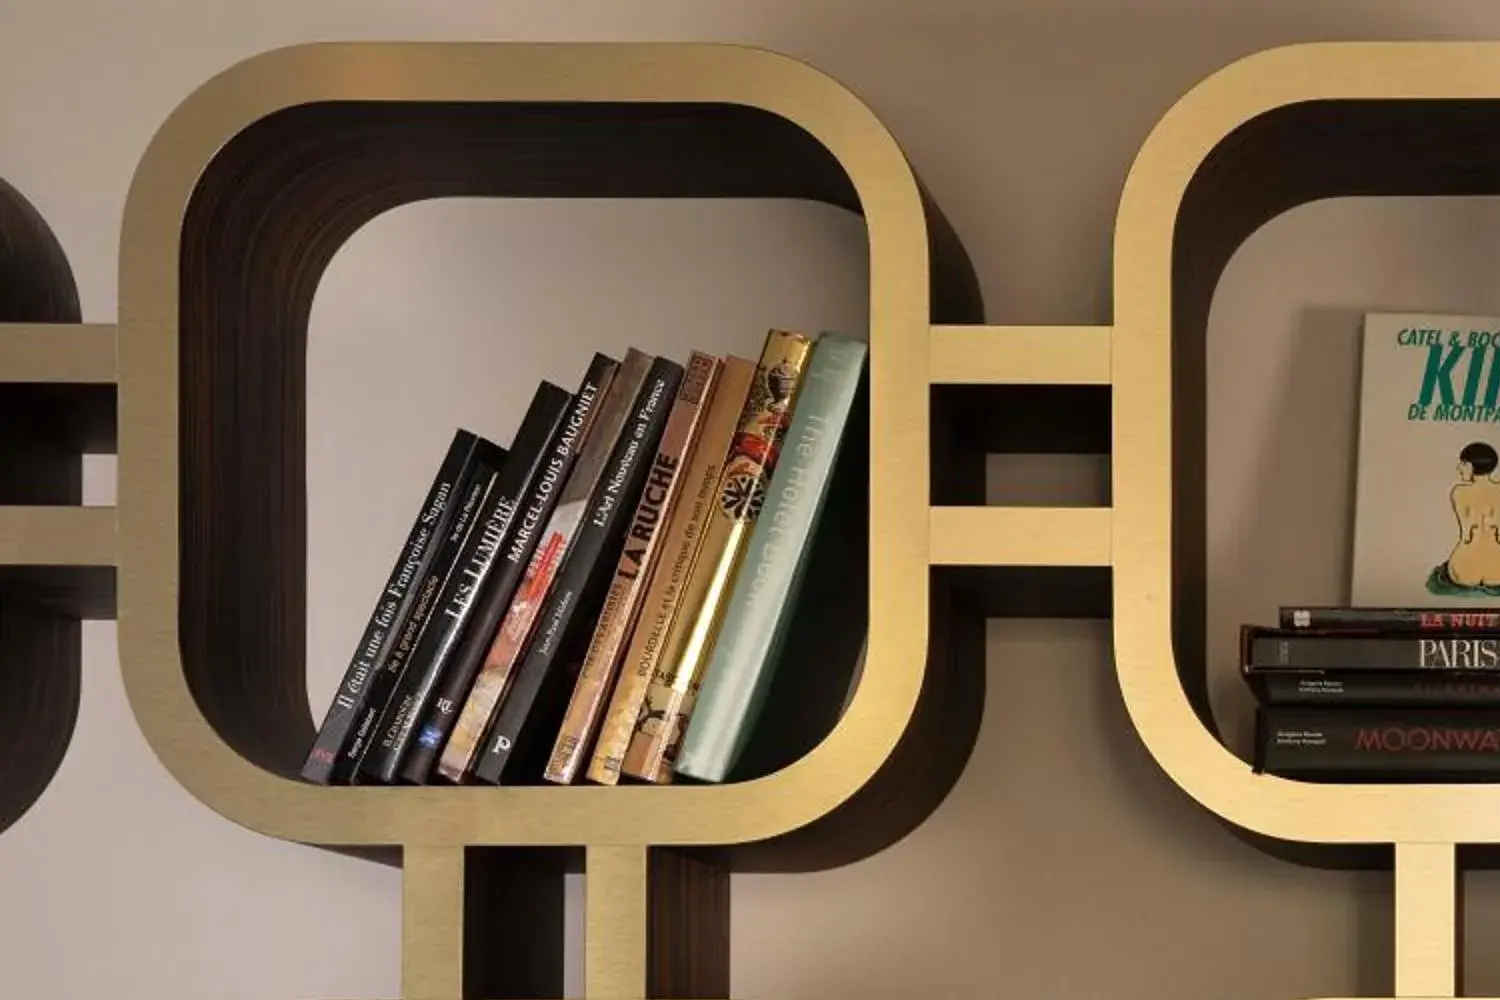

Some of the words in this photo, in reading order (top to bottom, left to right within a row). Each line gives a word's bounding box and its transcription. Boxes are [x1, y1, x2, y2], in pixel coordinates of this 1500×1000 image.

[1397, 329, 1444, 346] CATEL
[1448, 331, 1464, 347] &
[1407, 404, 1427, 421] DE
[505, 455, 565, 563] MARCEL-LOUIS
[555, 380, 600, 456] BAUGNIET
[605, 437, 642, 495] Nouveau
[628, 451, 679, 543] RUCHE
[363, 629, 385, 658] une
[375, 598, 399, 627] fois
[388, 526, 436, 599] Françoise
[421, 479, 455, 527] Sagan
[617, 543, 646, 581] LA
[1420, 613, 1443, 627] LA
[1452, 613, 1494, 627] NUIT
[1419, 639, 1499, 668] PARIS
